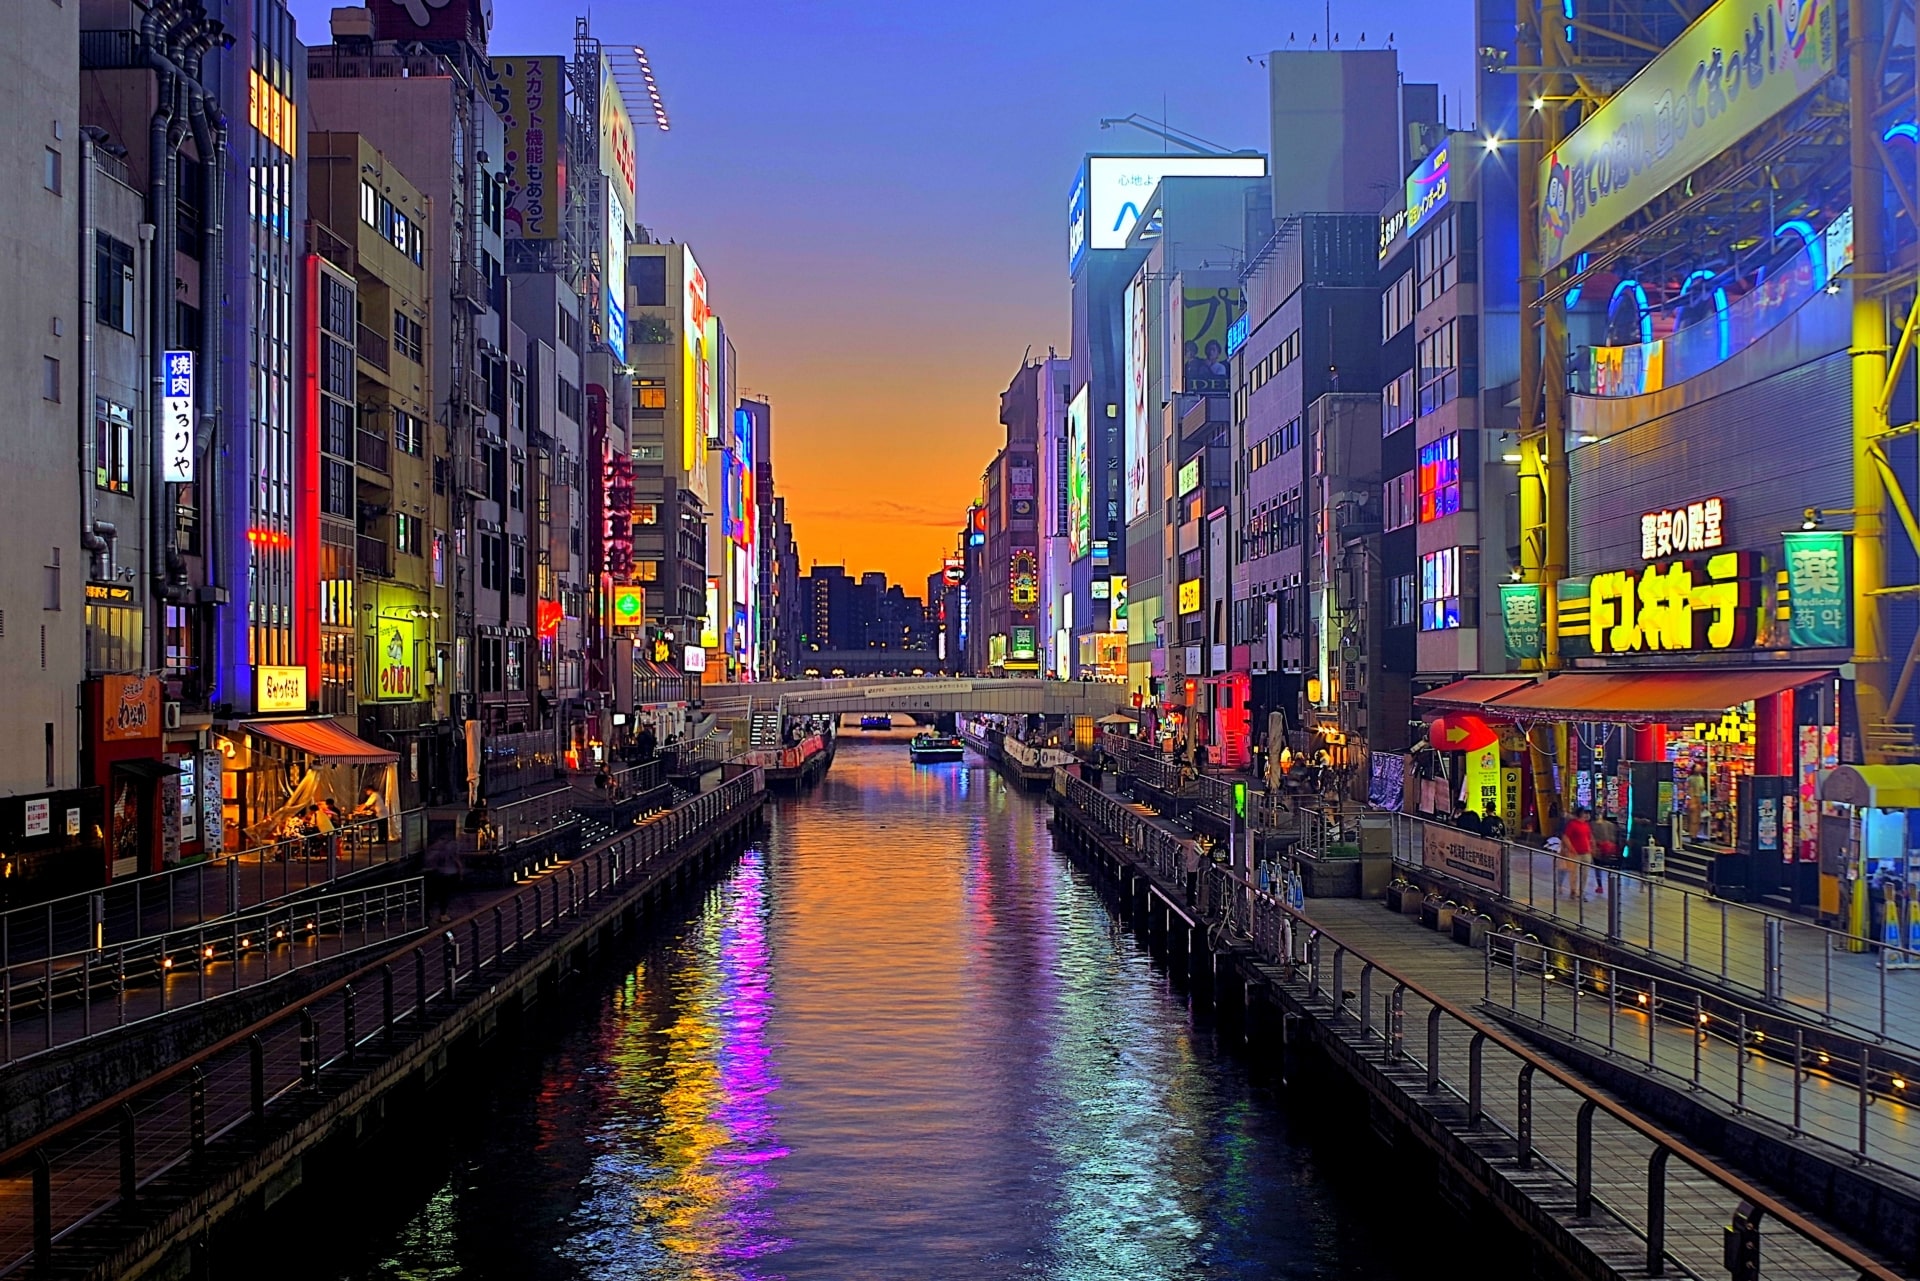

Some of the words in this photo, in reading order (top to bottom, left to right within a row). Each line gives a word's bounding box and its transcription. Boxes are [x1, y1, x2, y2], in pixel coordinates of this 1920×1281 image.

[526, 60, 543, 233] スカウト機能もあるで
[1118, 175, 1161, 187] 心地よ
[171, 355, 190, 395] 焼肉
[173, 400, 190, 478] いろりや
[1641, 498, 1722, 560] 驚安の殿堂
[1791, 549, 1840, 595] 薬
[1505, 594, 1537, 625] 薬
[1793, 598, 1842, 606] Medicine
[1821, 608, 1842, 630] 약
